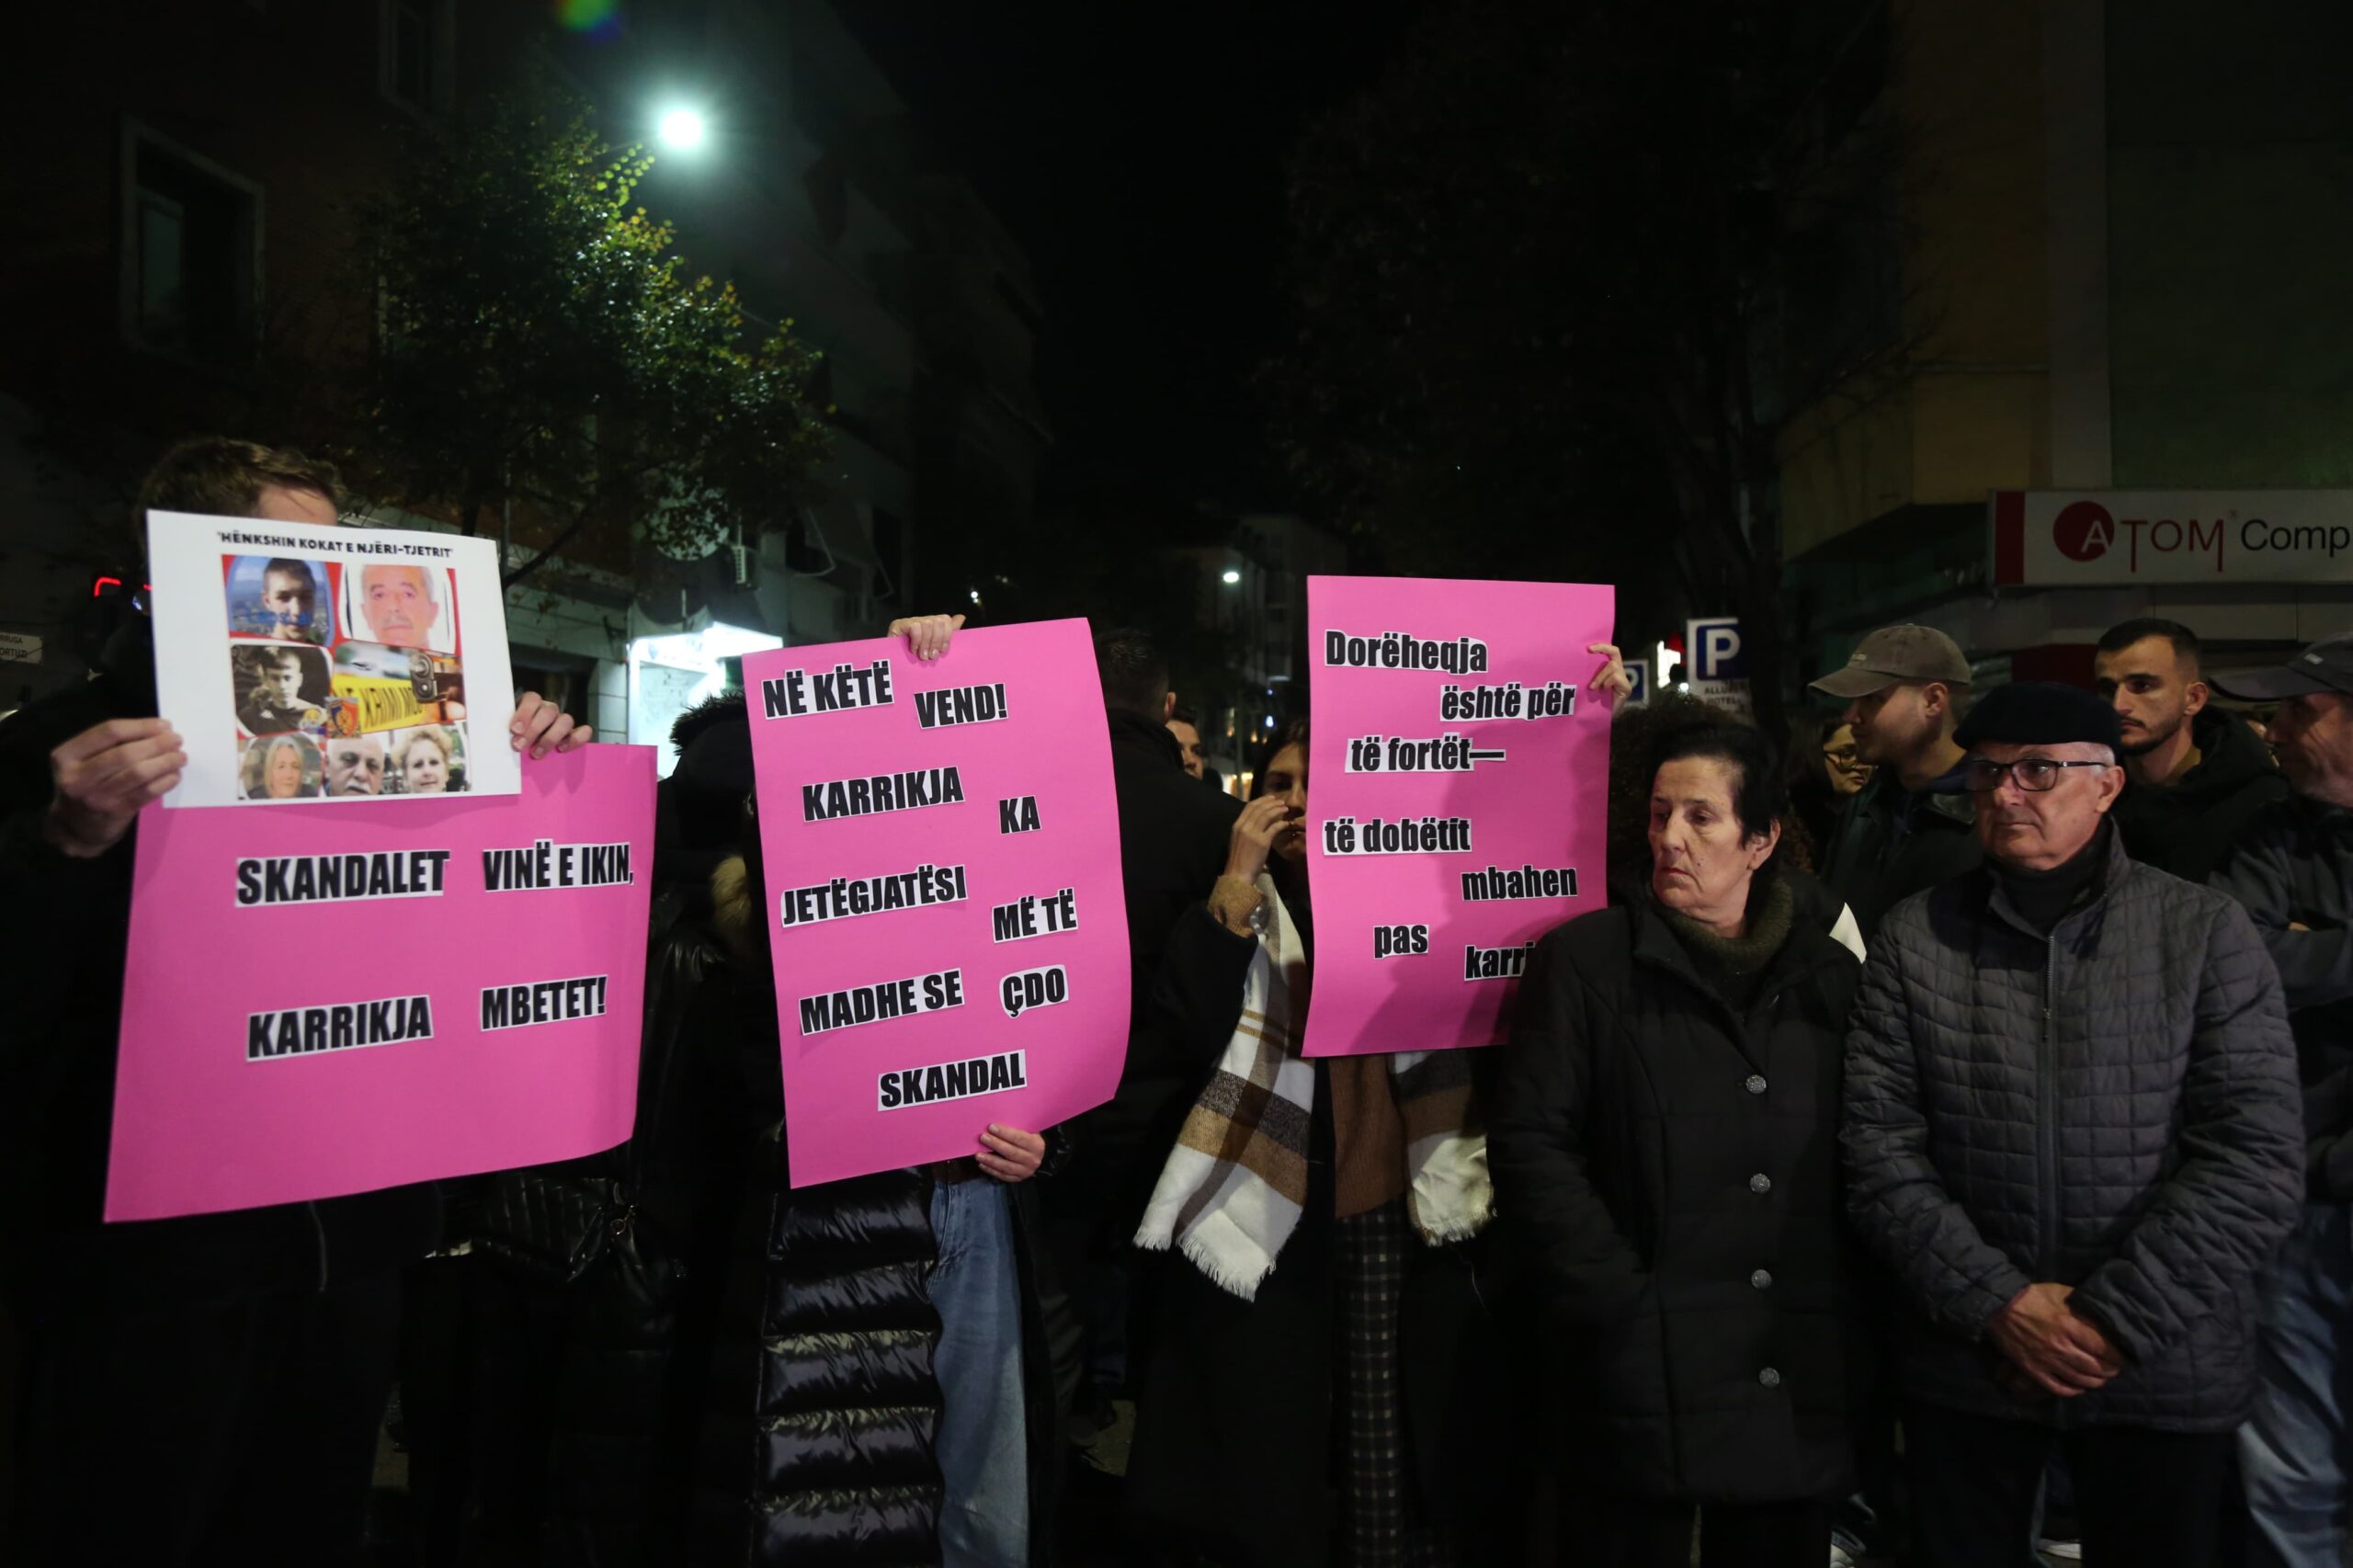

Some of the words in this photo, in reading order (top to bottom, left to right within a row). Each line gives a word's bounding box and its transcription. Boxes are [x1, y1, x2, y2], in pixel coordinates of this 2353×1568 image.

[299, 538, 343, 552] KOKAT
[347, 542, 354, 553] E
[1325, 631, 1487, 675] Dorëheqja
[762, 670, 807, 718] NË
[813, 660, 893, 711] KËTË
[915, 683, 1007, 728] VEND!
[1441, 683, 1521, 720] është
[1527, 682, 1575, 720] për
[1351, 736, 1381, 771] të
[802, 766, 964, 821] KARRIKJA
[999, 795, 1041, 834] KA
[1324, 818, 1356, 853] të
[1362, 817, 1471, 852] dobëtit
[236, 850, 450, 904] SKANDALET
[483, 841, 551, 892] VINË
[559, 847, 574, 887] E
[582, 844, 633, 886] IKIN,
[1461, 865, 1578, 901] mbahen
[782, 865, 967, 925] JETËGJATËSI
[993, 895, 1038, 941] MË
[1041, 889, 1077, 932] TË
[1374, 925, 1428, 959] pas
[1466, 940, 1534, 979] karr
[247, 996, 432, 1059] KARRIKJA
[482, 976, 608, 1030] MBETET!
[800, 979, 918, 1034] MADHE
[923, 970, 963, 1009] SE
[1003, 968, 1065, 1017] ÇDO
[880, 1052, 1025, 1108] SKANDAL
